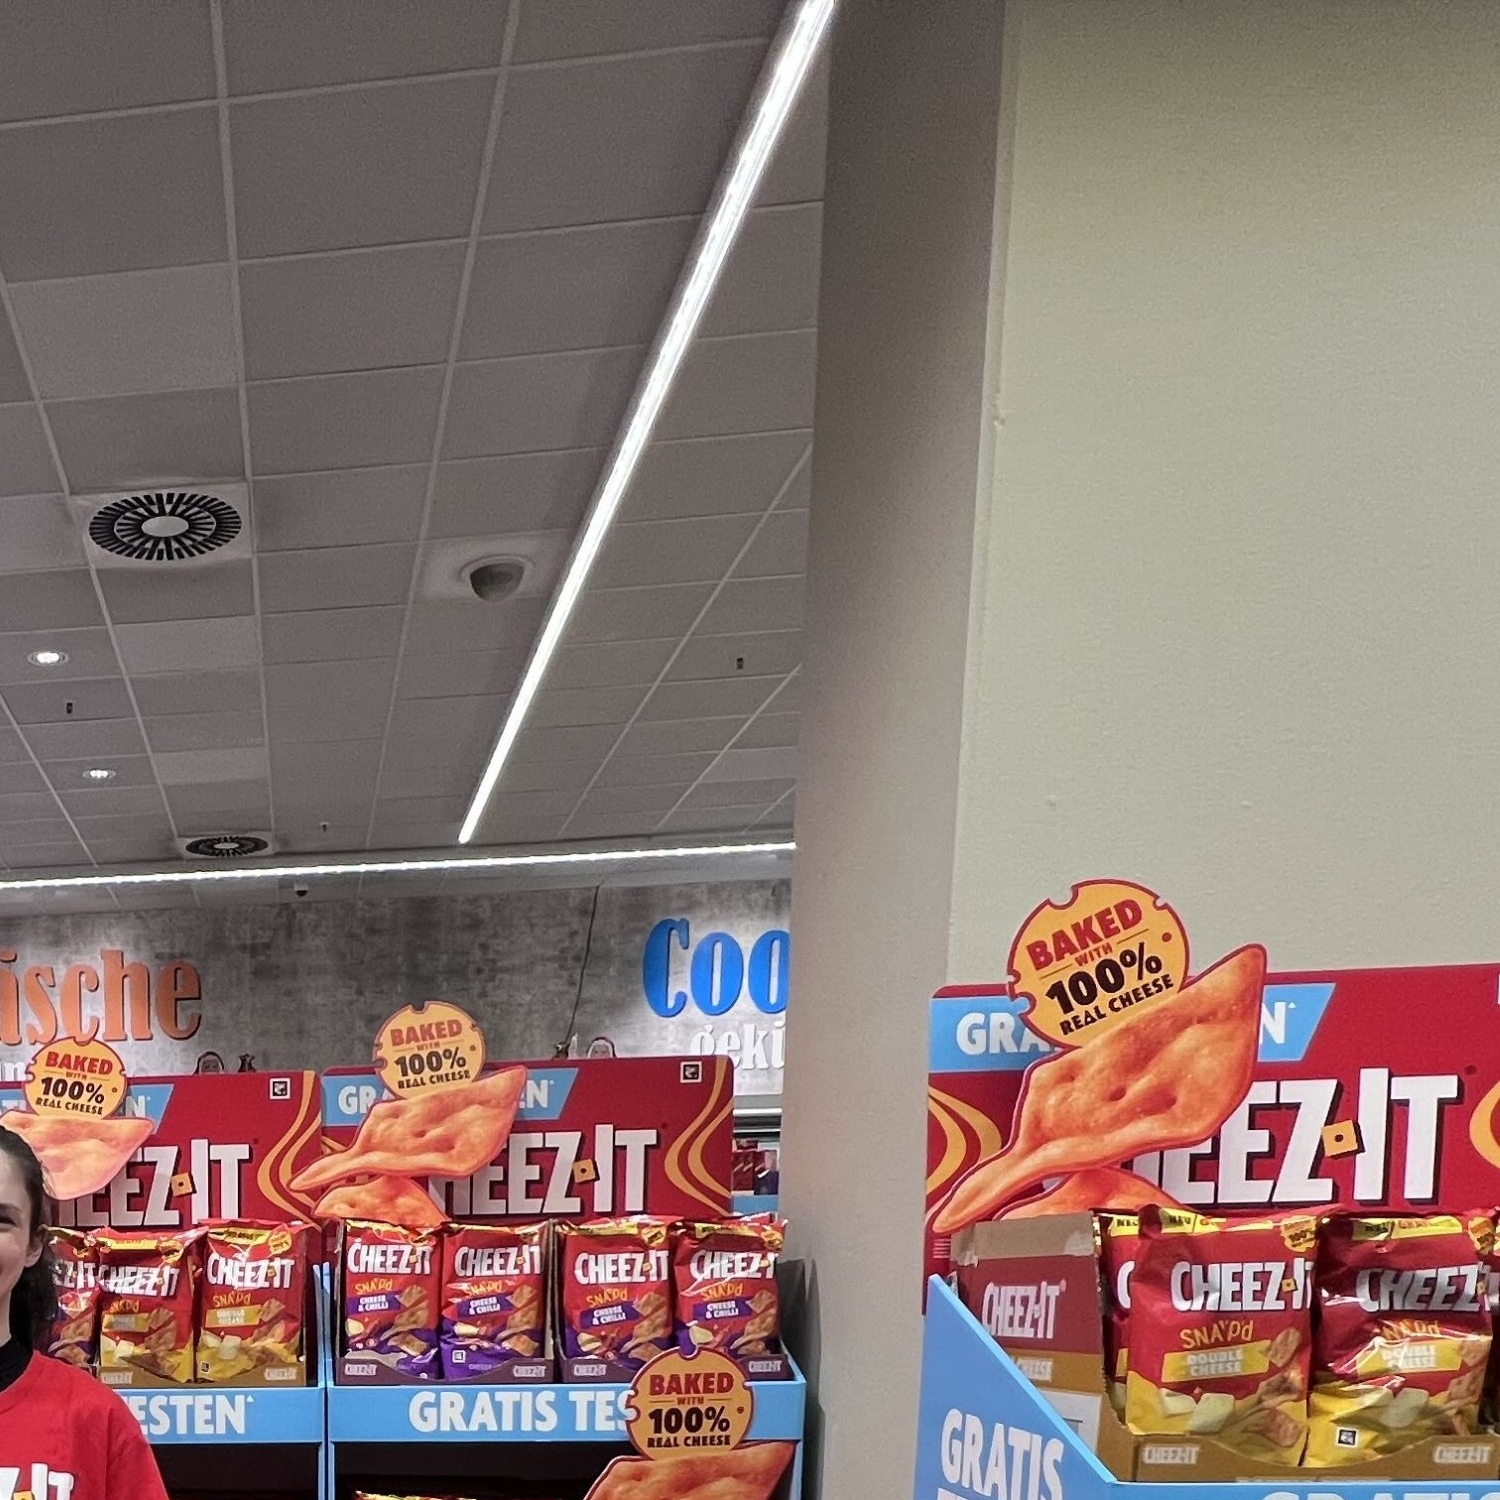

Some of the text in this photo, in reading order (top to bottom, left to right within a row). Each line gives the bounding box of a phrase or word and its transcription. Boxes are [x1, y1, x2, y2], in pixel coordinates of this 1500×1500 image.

[1027, 899, 1143, 971] BAKED
[1073, 944, 1114, 968] WITH
[1045, 941, 1163, 1014] 100%
[1059, 973, 1174, 1037] REAL CHEESE
[390, 1018, 463, 1047] BAKED
[44, 1051, 113, 1076] BAKED
[395, 1046, 467, 1077] 100%
[40, 1076, 105, 1104] 100%
[397, 1069, 471, 1090] REAL CHEESE
[35, 1097, 62, 1110] REAL
[65, 1101, 104, 1116] CHEESE
[359, 1295, 387, 1304] CHEESE
[469, 1297, 498, 1307] CHEESE
[593, 1306, 623, 1317] CHEESE
[706, 1301, 736, 1311] CHEESE
[1186, 1350, 1244, 1365] DOUBLE
[1189, 1361, 1242, 1376] CHEESE
[649, 1373, 734, 1397] BAKED
[122, 1395, 246, 1435] ESTEN
[408, 1391, 558, 1432] GRATIS
[648, 1405, 731, 1435] 100%
[647, 1434, 732, 1449] REAL CHEESE
